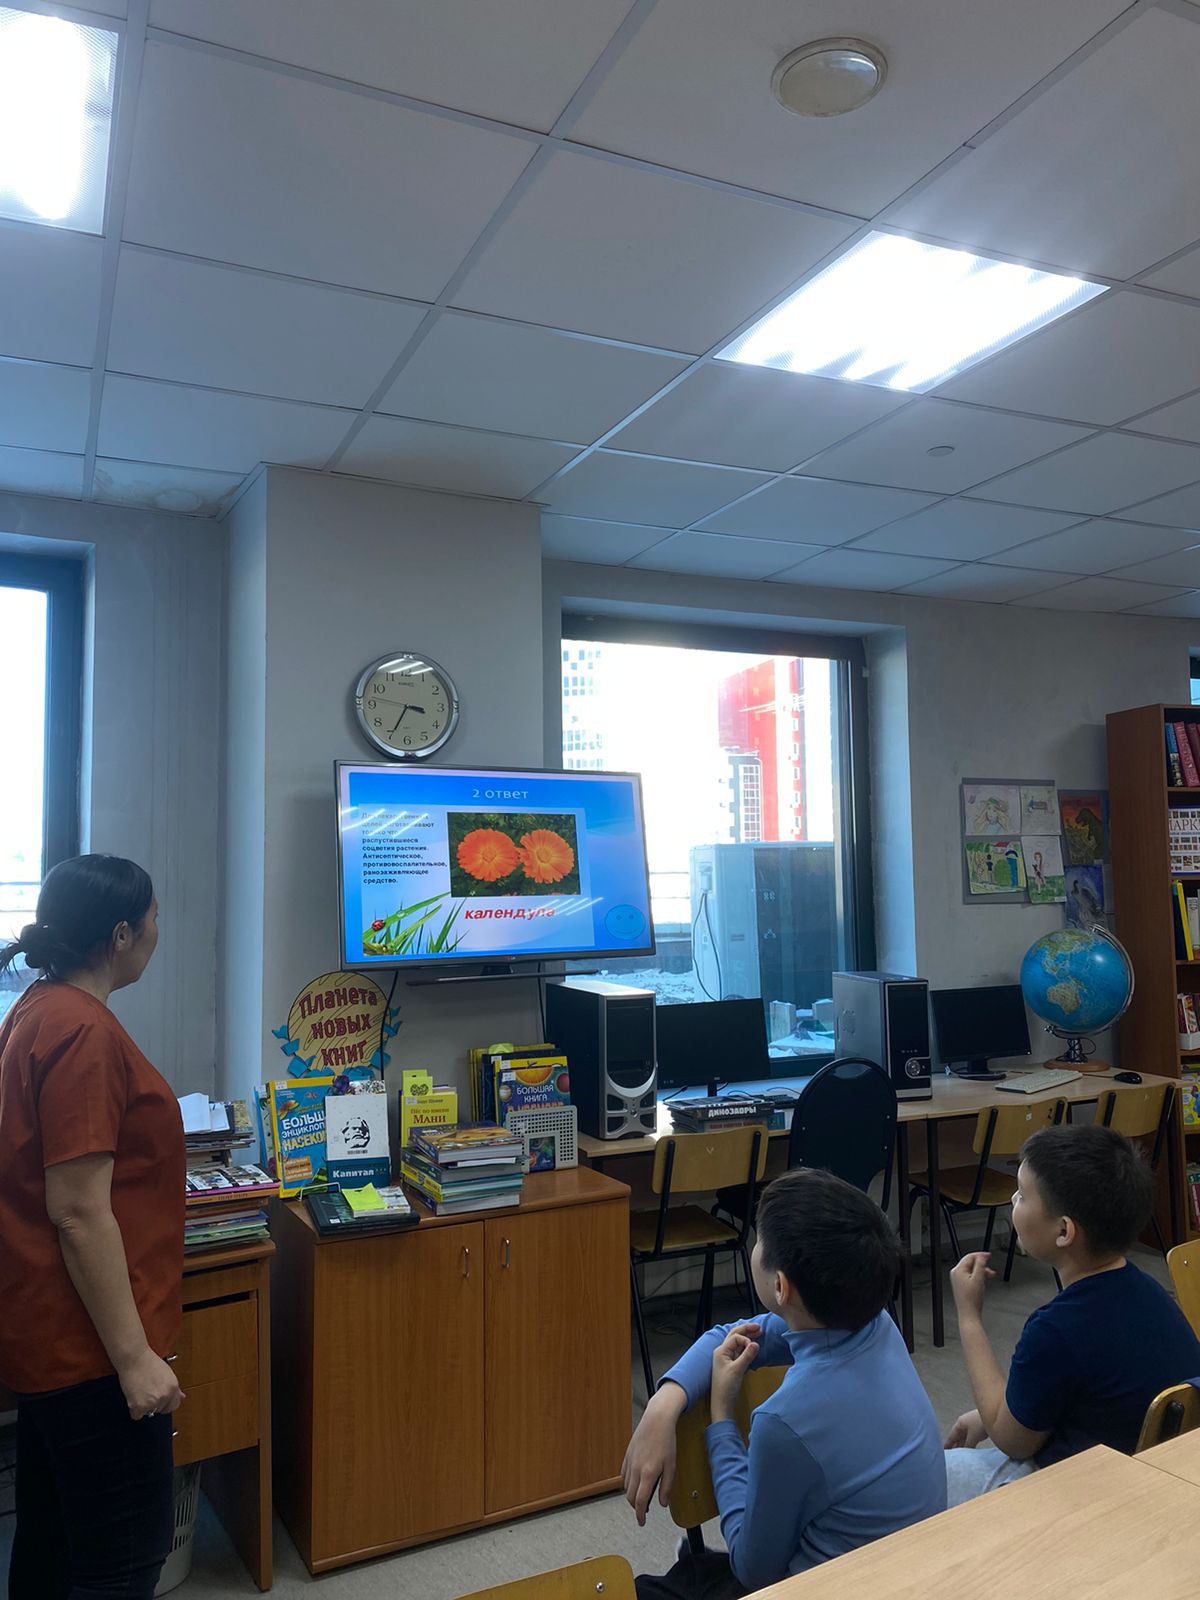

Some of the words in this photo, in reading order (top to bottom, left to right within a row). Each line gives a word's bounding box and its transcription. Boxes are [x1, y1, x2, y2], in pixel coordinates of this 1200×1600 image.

[373, 683, 386, 694] 10
[431, 685, 440, 695] 2
[367, 700, 377, 710] 9
[437, 703, 445, 713] 3
[373, 718, 382, 728] 8
[431, 719, 440, 729] 4
[386, 729, 395, 740] 7
[420, 731, 429, 741] 5
[403, 735, 412, 745] 6
[472, 788, 480, 798] 2
[485, 789, 529, 799] ответ
[362, 845, 395, 853] соцветия
[362, 860, 448, 869] противовоспалительное,
[363, 868, 429, 876] ранозаживляющее
[363, 876, 398, 885] средство.
[465, 908, 556, 920] календула
[299, 987, 378, 1019] Планета
[311, 1013, 372, 1039] новых
[321, 1040, 367, 1066] книг
[516, 1084, 554, 1095] БОЛЬШАЯ
[524, 1094, 548, 1103] КНИГА
[708, 1106, 757, 1118] ДИНОЗАВРЫ
[333, 1168, 375, 1178] Капитал
